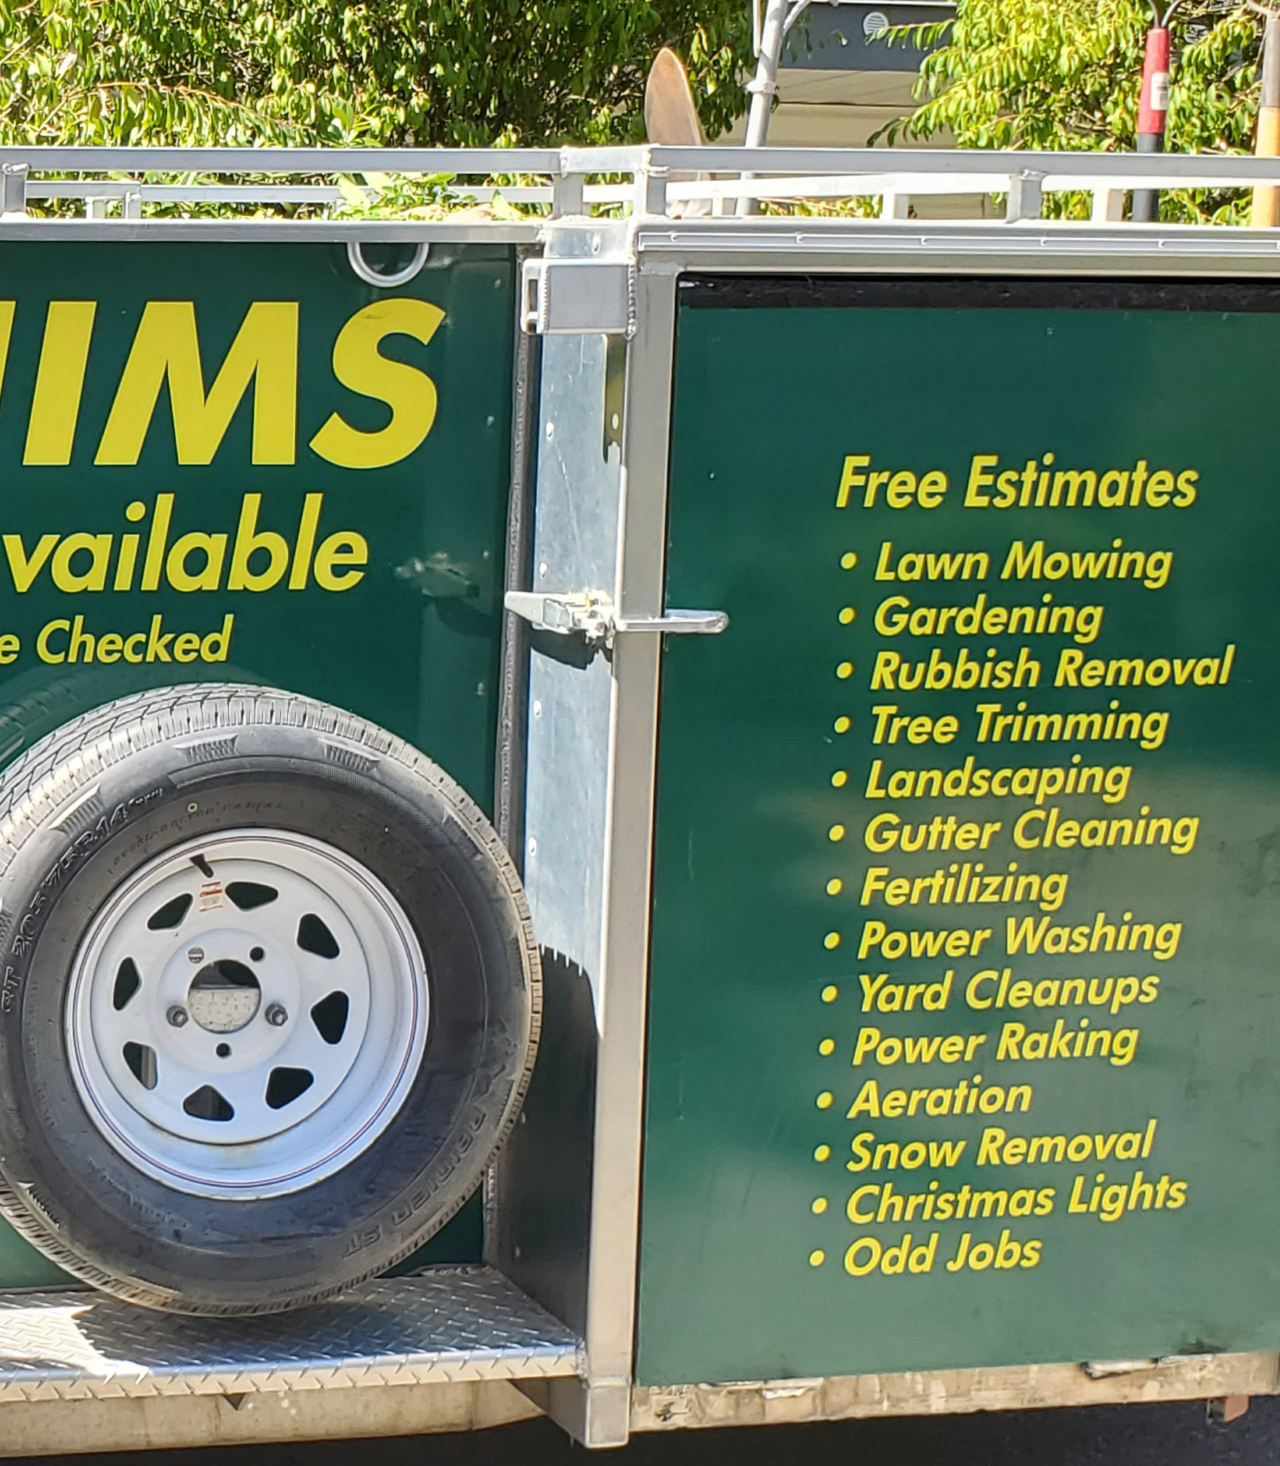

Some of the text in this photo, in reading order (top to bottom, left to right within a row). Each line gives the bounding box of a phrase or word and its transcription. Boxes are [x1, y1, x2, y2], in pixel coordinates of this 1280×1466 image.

[838, 453, 1198, 508] Free Estimates
[877, 539, 1172, 588] Lawn Mowing
[38, 616, 233, 663] Checked
[876, 594, 1103, 643] Gardening
[872, 646, 1234, 690] Rubbish Removal
[874, 701, 1169, 749] Tree Trimming
[867, 756, 1131, 805] Landscaping
[865, 807, 1199, 854] Gutter Cleaning
[862, 862, 1068, 911] Fertilizing
[859, 912, 1182, 960] Power Washing
[861, 968, 1159, 1012] Yard Cleanups
[854, 1020, 1140, 1065] Power Raking
[850, 1076, 1033, 1118] Aeration
[849, 1119, 1155, 1170] Snow Removal
[849, 1173, 1187, 1222] Christmas Lights
[845, 1229, 1042, 1276] Odd Jobs
